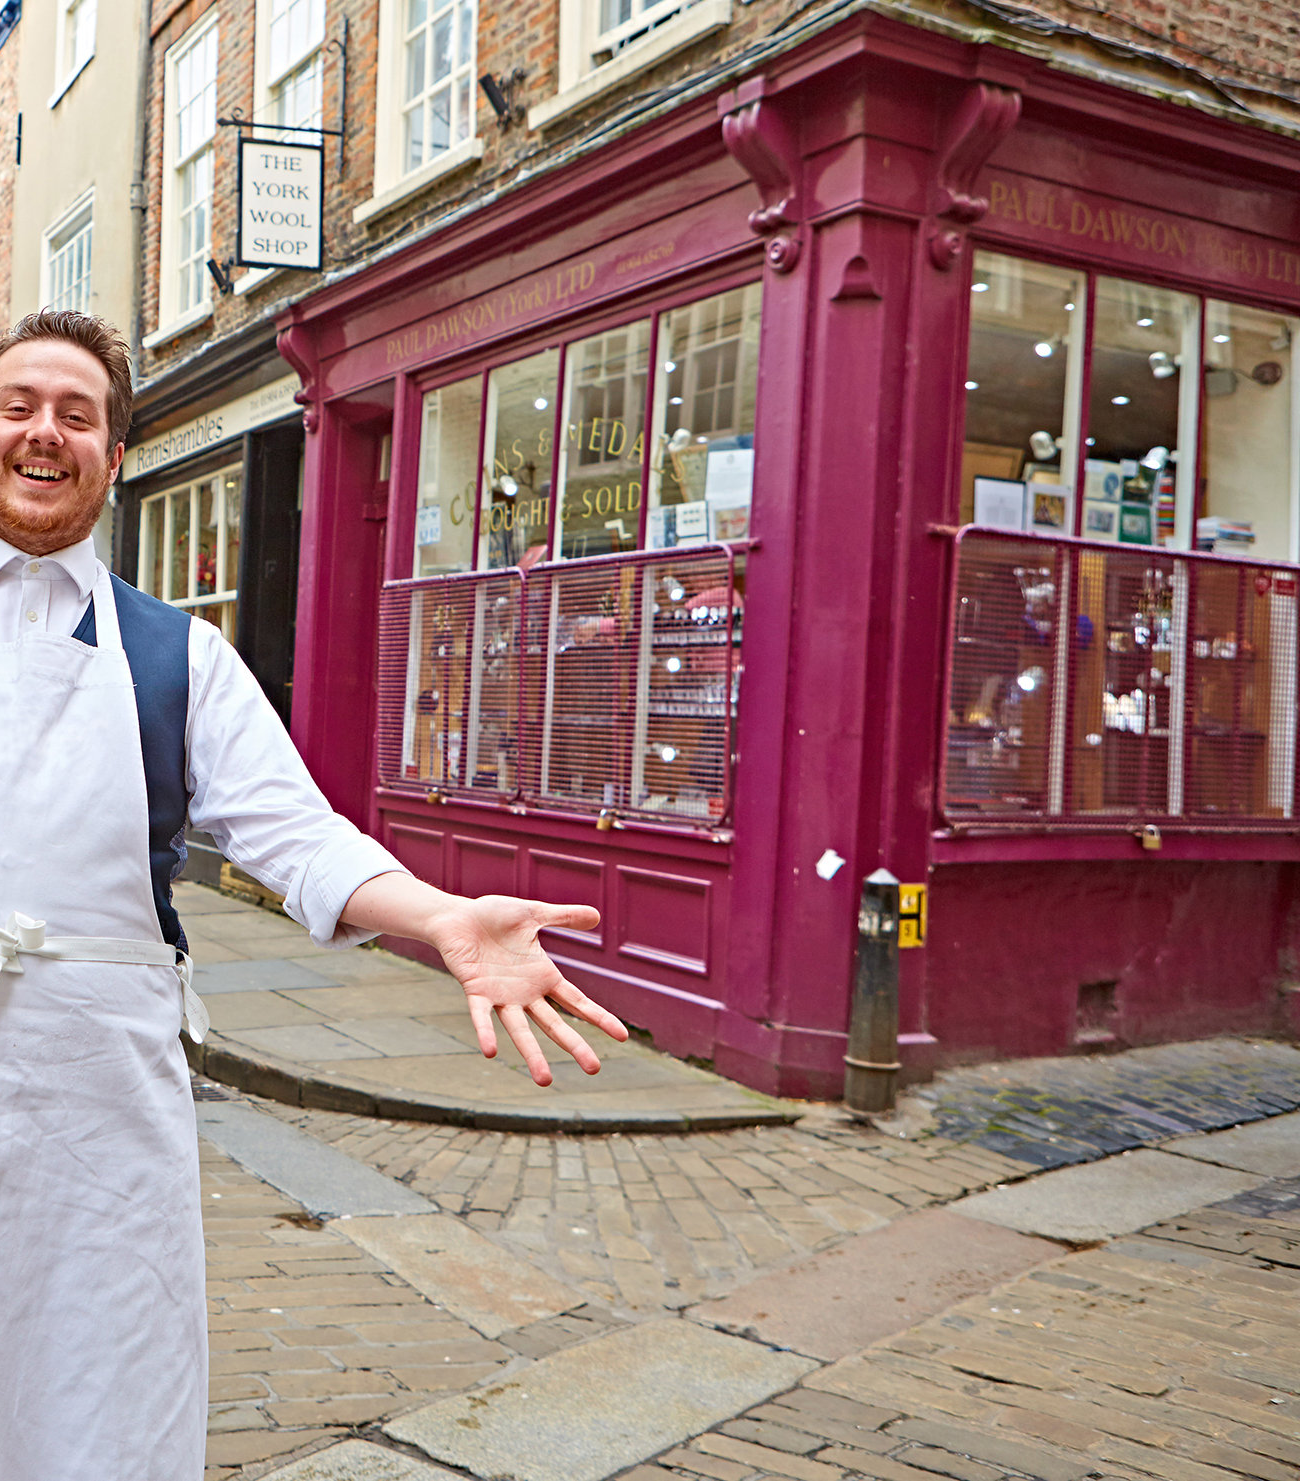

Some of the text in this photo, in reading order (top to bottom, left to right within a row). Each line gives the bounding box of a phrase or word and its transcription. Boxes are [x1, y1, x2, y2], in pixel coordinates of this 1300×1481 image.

[260, 154, 302, 172] THE
[252, 181, 309, 200] YORK
[250, 209, 312, 228] WOOL
[989, 181, 1063, 231] PAUL
[1069, 200, 1189, 257] DAWSON
[252, 238, 308, 255] SHOP
[386, 330, 424, 364] PAUL
[426, 298, 496, 350] DAWSON
[500, 279, 551, 323] (York)
[555, 260, 596, 300] LTD
[136, 414, 223, 472] Ramshambles
[479, 497, 550, 536] BOUGHT
[581, 481, 642, 519] SOLD
